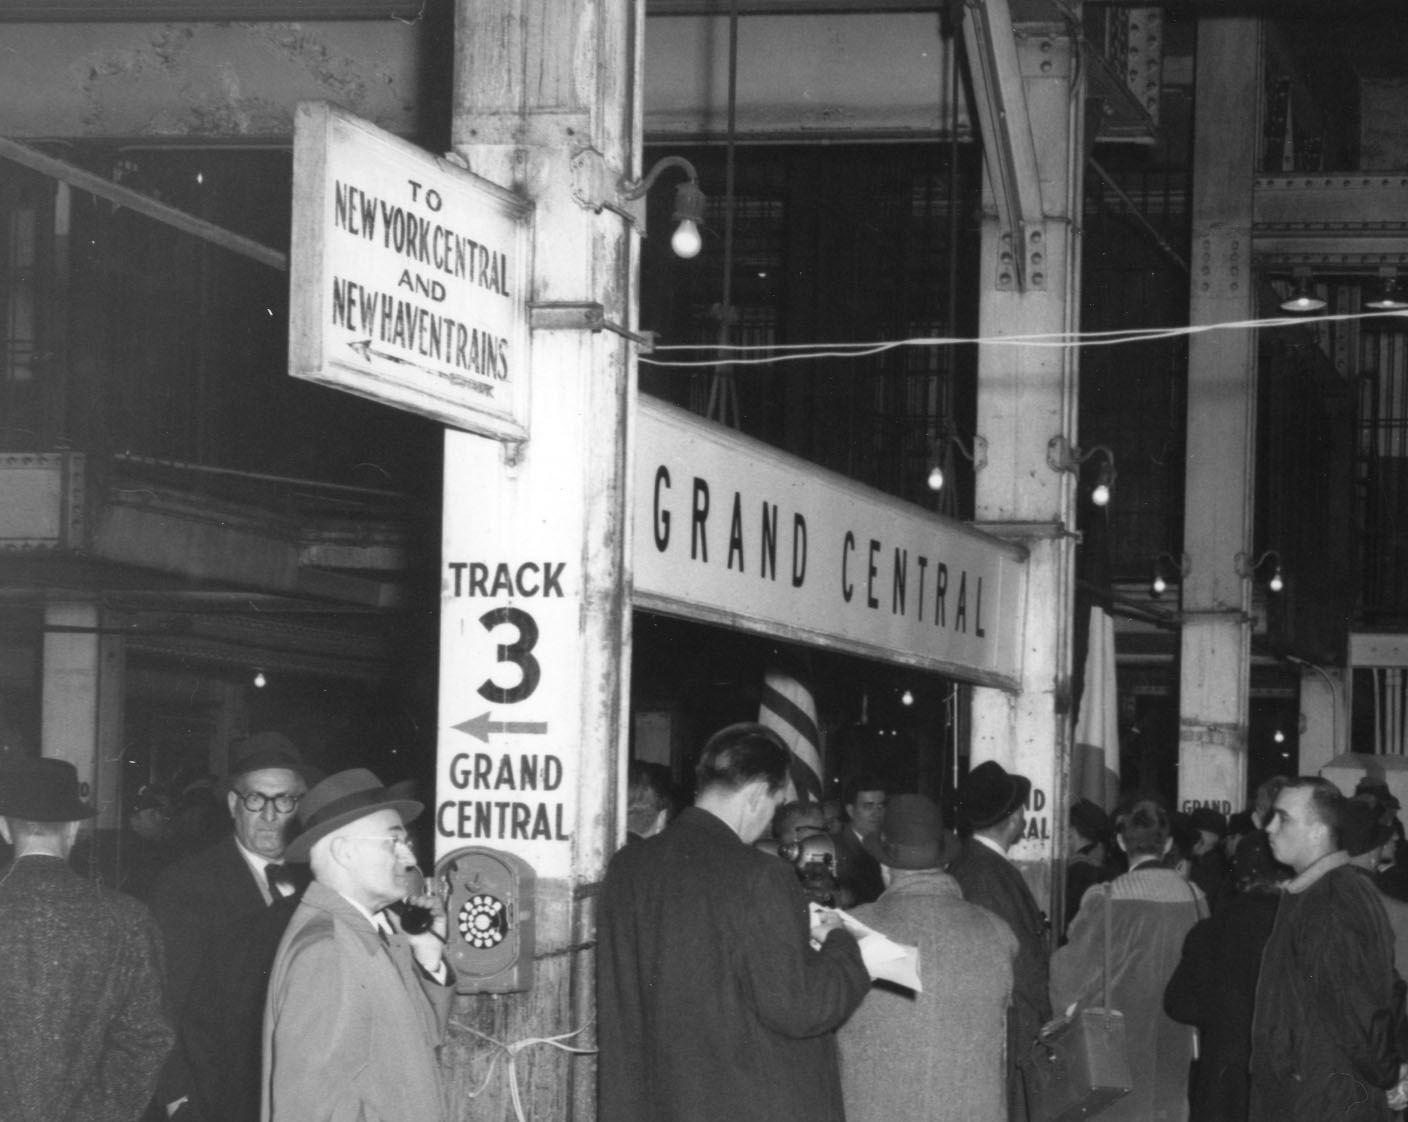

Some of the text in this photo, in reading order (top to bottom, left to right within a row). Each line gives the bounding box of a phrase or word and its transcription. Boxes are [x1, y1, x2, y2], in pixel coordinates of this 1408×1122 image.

[408, 180, 442, 213] TO
[335, 180, 510, 298] NEW YORK CENTRAL
[398, 269, 446, 302] AND
[332, 276, 508, 380] NEW HAVEN TRAINS
[653, 465, 985, 638] GRAND CENTRAL
[448, 562, 566, 598] TRACK
[476, 606, 541, 704] 3
[449, 752, 563, 791] GRAND
[437, 801, 569, 841] CENTRAL
